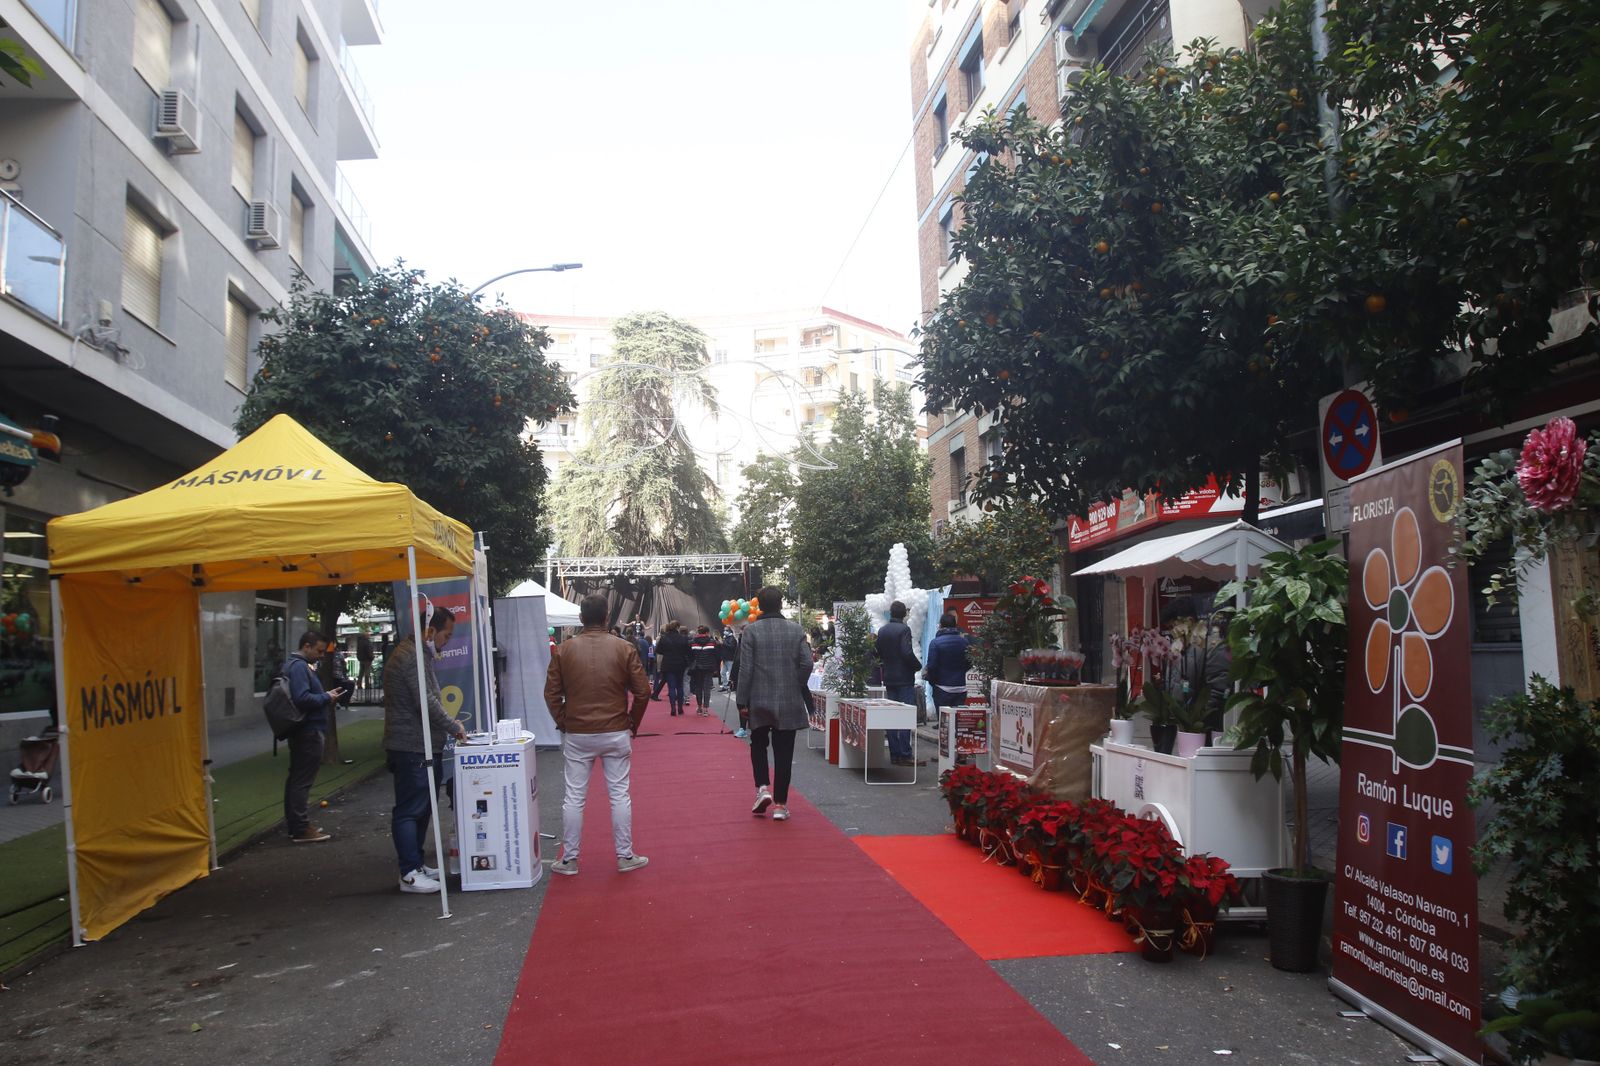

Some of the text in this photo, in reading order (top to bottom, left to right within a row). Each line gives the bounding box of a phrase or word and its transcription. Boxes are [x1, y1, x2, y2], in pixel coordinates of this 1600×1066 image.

[170, 465, 328, 490] MÁSMÓVIL
[1352, 497, 1395, 523] FLORISTA
[81, 670, 182, 732] MÁSMÓVIL
[460, 753, 520, 765] LOVATEC
[1358, 772, 1454, 820] Ramón Luque
[1344, 864, 1469, 928] C/ Alcalde Velasco Navarro, 1
[1344, 900, 1358, 920] Telf.
[1360, 909, 1371, 926] 957
[1372, 916, 1384, 934] 232
[1385, 924, 1401, 942] 461
[1409, 934, 1426, 953] 607
[1429, 943, 1448, 963] 864
[1451, 952, 1469, 973] 033
[1395, 908, 1436, 936] Córdoba
[1340, 938, 1472, 1021] ramonluqueflorista@gmail.com
[1358, 930, 1444, 983] www.ramonluque.es
